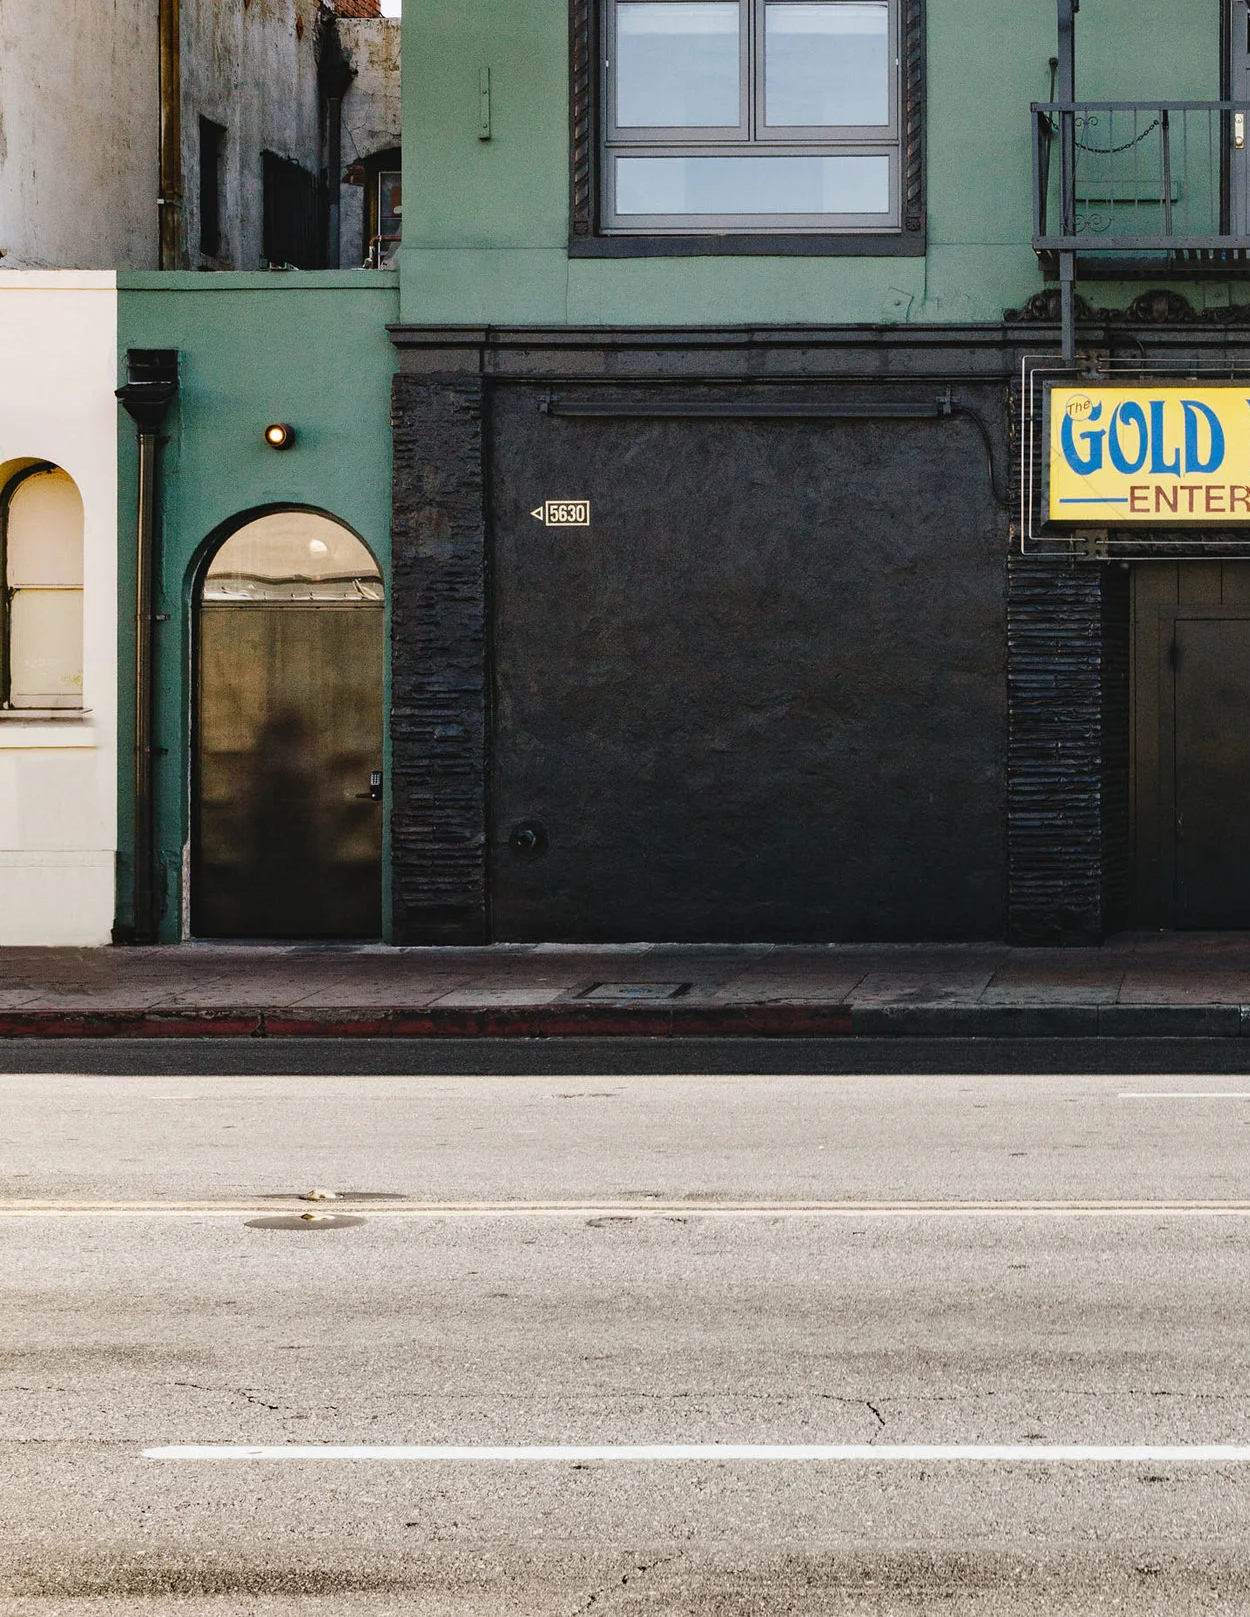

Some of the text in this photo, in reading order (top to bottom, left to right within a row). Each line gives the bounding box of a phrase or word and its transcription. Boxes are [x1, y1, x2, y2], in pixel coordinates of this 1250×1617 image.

[1067, 400, 1091, 416] The
[1061, 399, 1225, 478] GOLD
[549, 504, 586, 522] 5630
